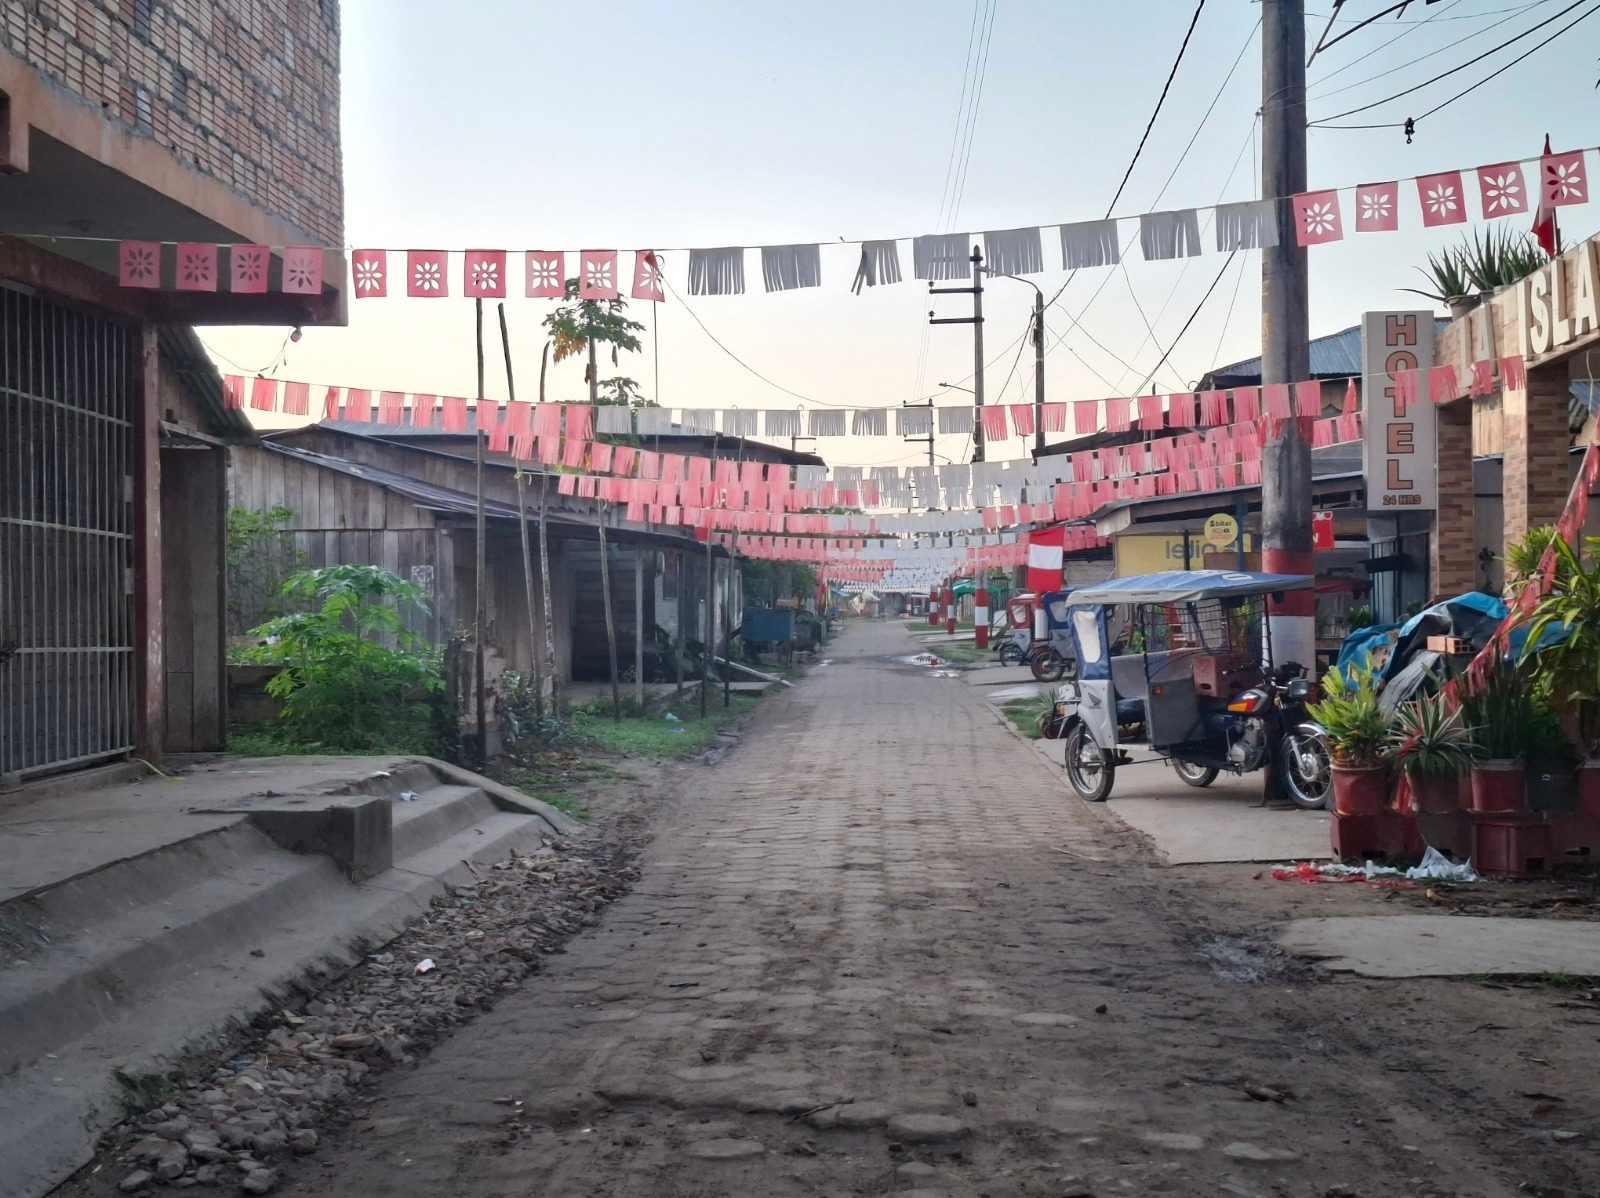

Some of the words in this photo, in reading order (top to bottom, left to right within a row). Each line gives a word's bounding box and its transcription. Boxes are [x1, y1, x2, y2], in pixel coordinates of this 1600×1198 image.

[1516, 241, 1598, 361] ISLA
[1385, 315, 1418, 490] HOTEL
[1383, 495, 1397, 505] 24
[1398, 494, 1421, 505] HRS
